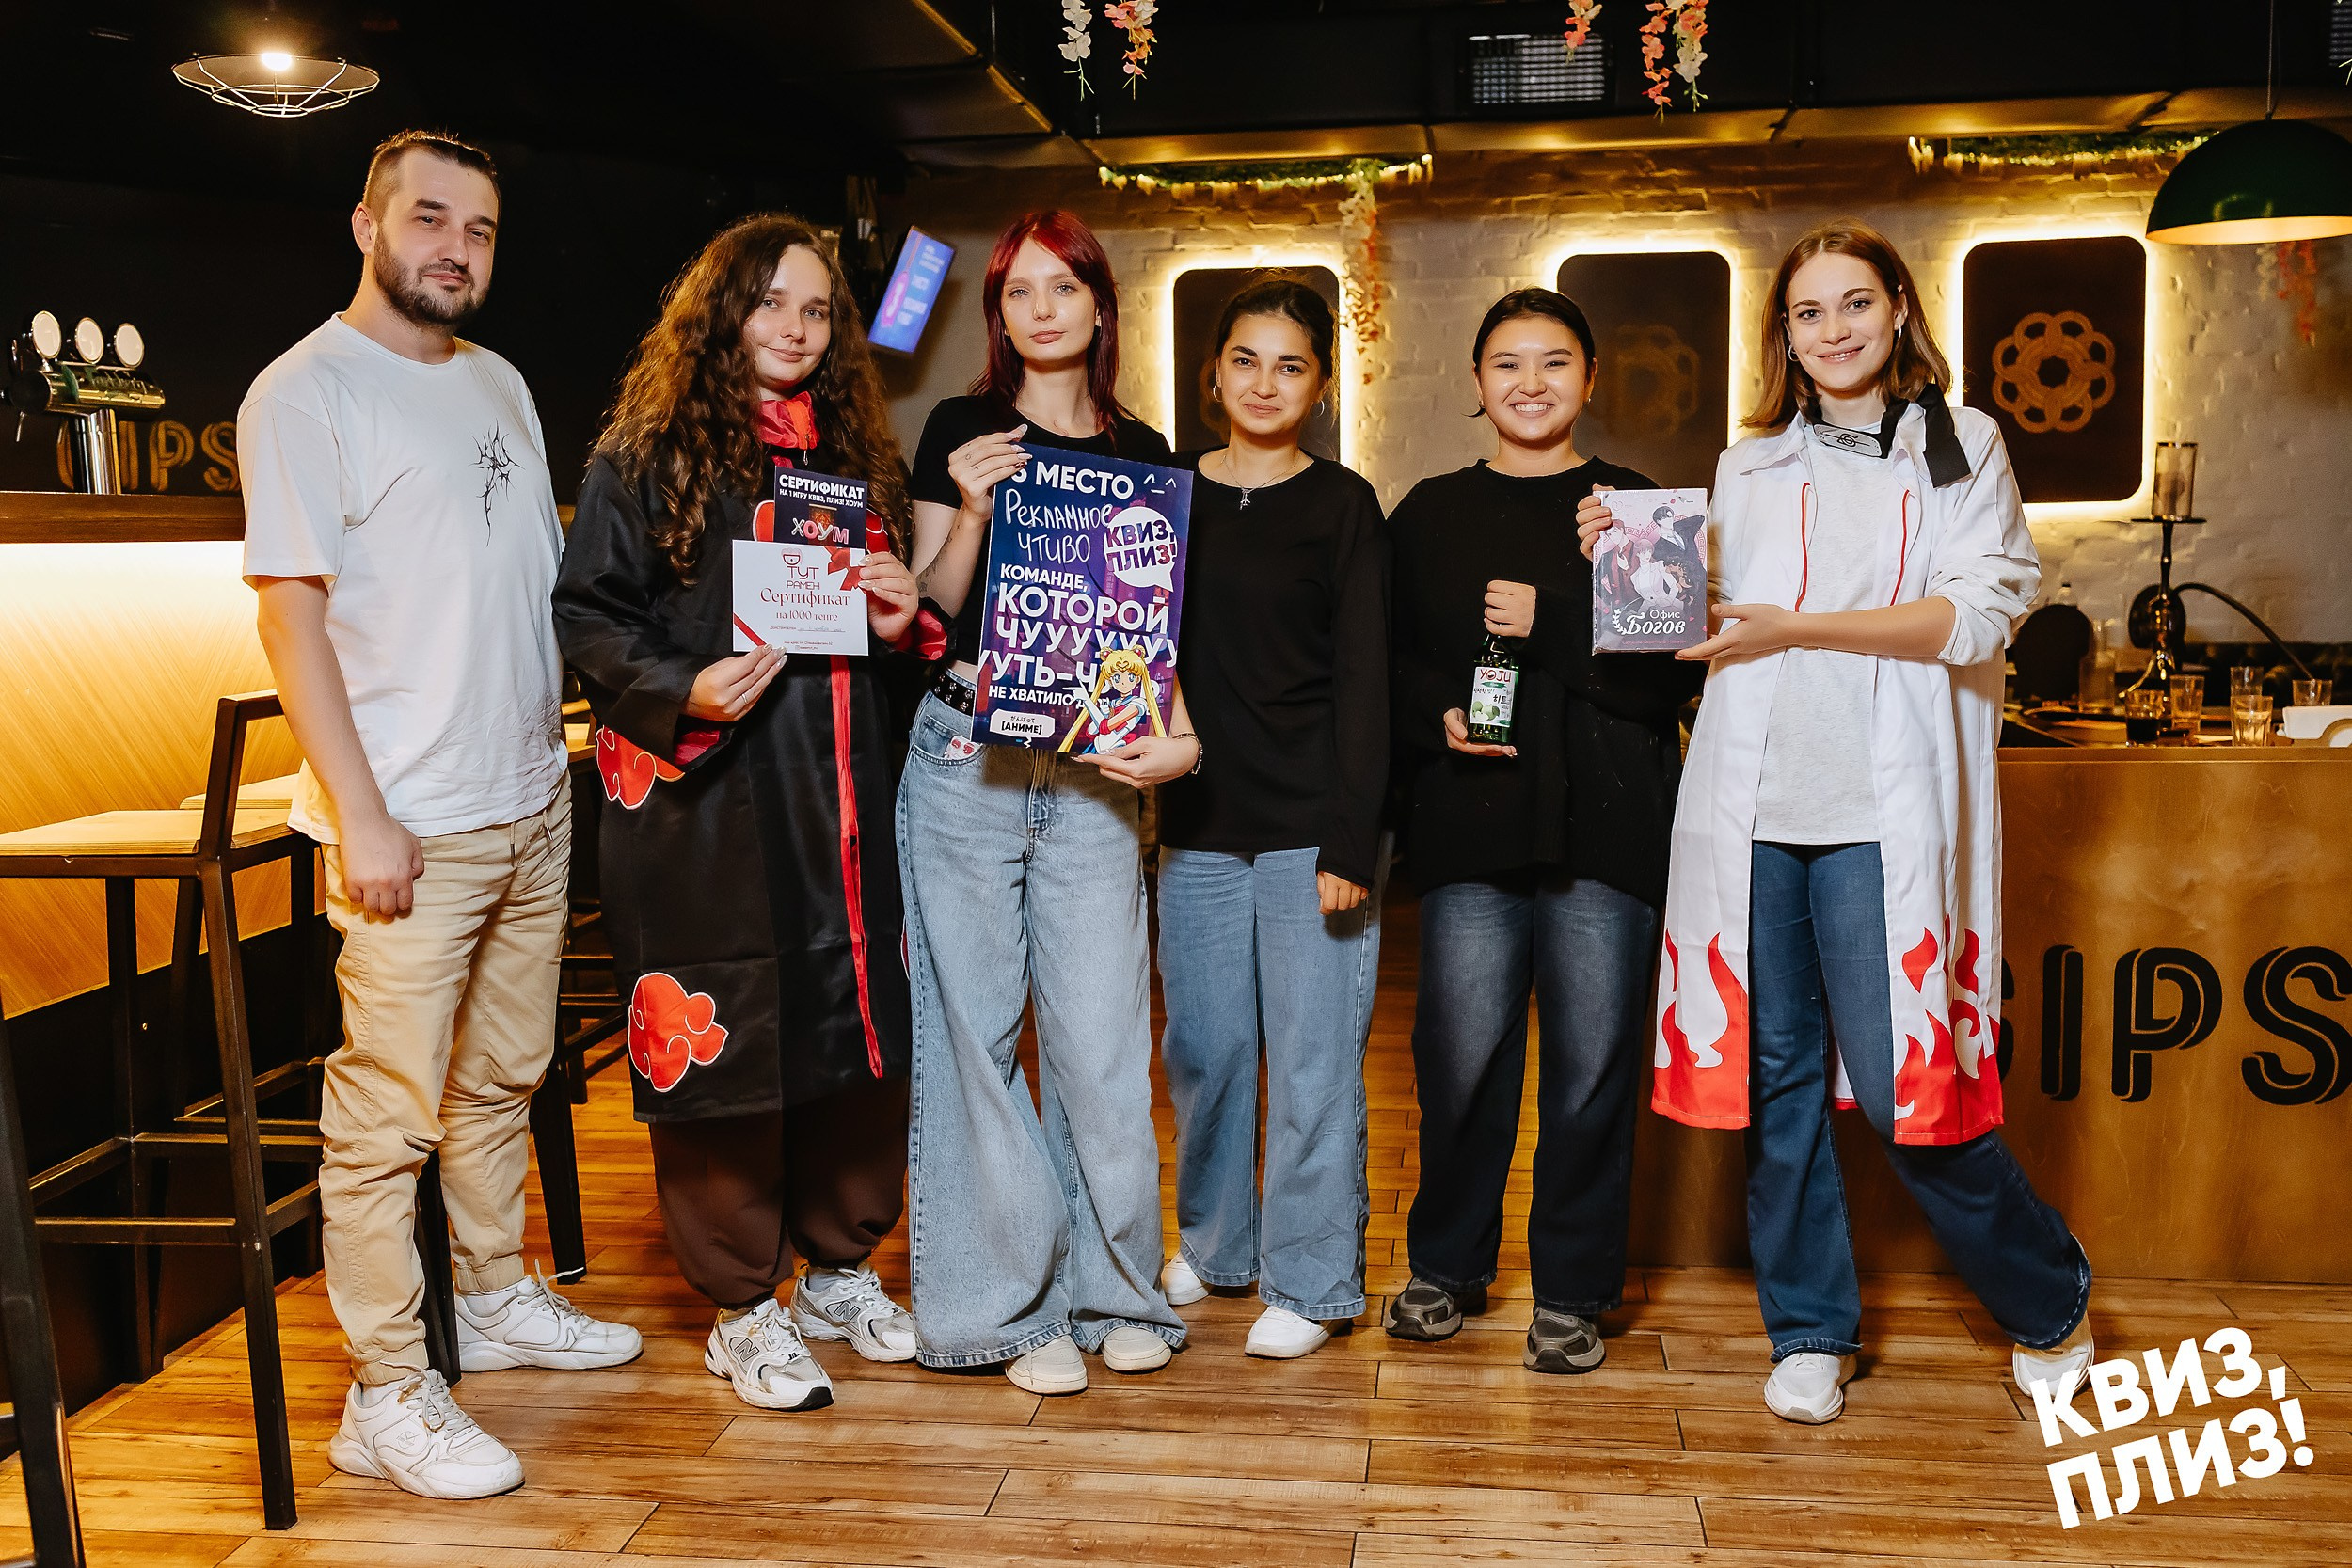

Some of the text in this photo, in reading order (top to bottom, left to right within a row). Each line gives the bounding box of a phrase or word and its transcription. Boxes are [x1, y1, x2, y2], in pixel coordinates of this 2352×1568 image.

[779, 474, 865, 499] СЕРТИФИКАТ
[1036, 461, 1134, 499] МЕСТО
[793, 490, 807, 499] ИГРУ
[808, 493, 825, 503] КВИЗ,
[826, 497, 844, 505] ПЛИЗ!
[846, 499, 863, 508] ХОУМ
[791, 517, 849, 545] ХОУМ
[1106, 519, 1175, 547] КВИЗ,
[1106, 543, 1176, 572] ПЛИЗ!
[787, 580, 820, 590] РАМЕН
[1001, 563, 1088, 592] КОМАНДЕ,
[760, 587, 850, 607] Сертификат
[997, 582, 1169, 634] КОТОРОЙ
[789, 610, 812, 620] 1000
[1626, 612, 1686, 635] Богов
[1649, 610, 1680, 621] Офис
[1480, 669, 1512, 683] YOJU
[989, 685, 1007, 699] НЕ
[1009, 688, 1074, 706] ХВАТИЛО
[1001, 721, 1042, 735] [АНИМЕ]
[1997, 944, 2352, 1106] IPS
